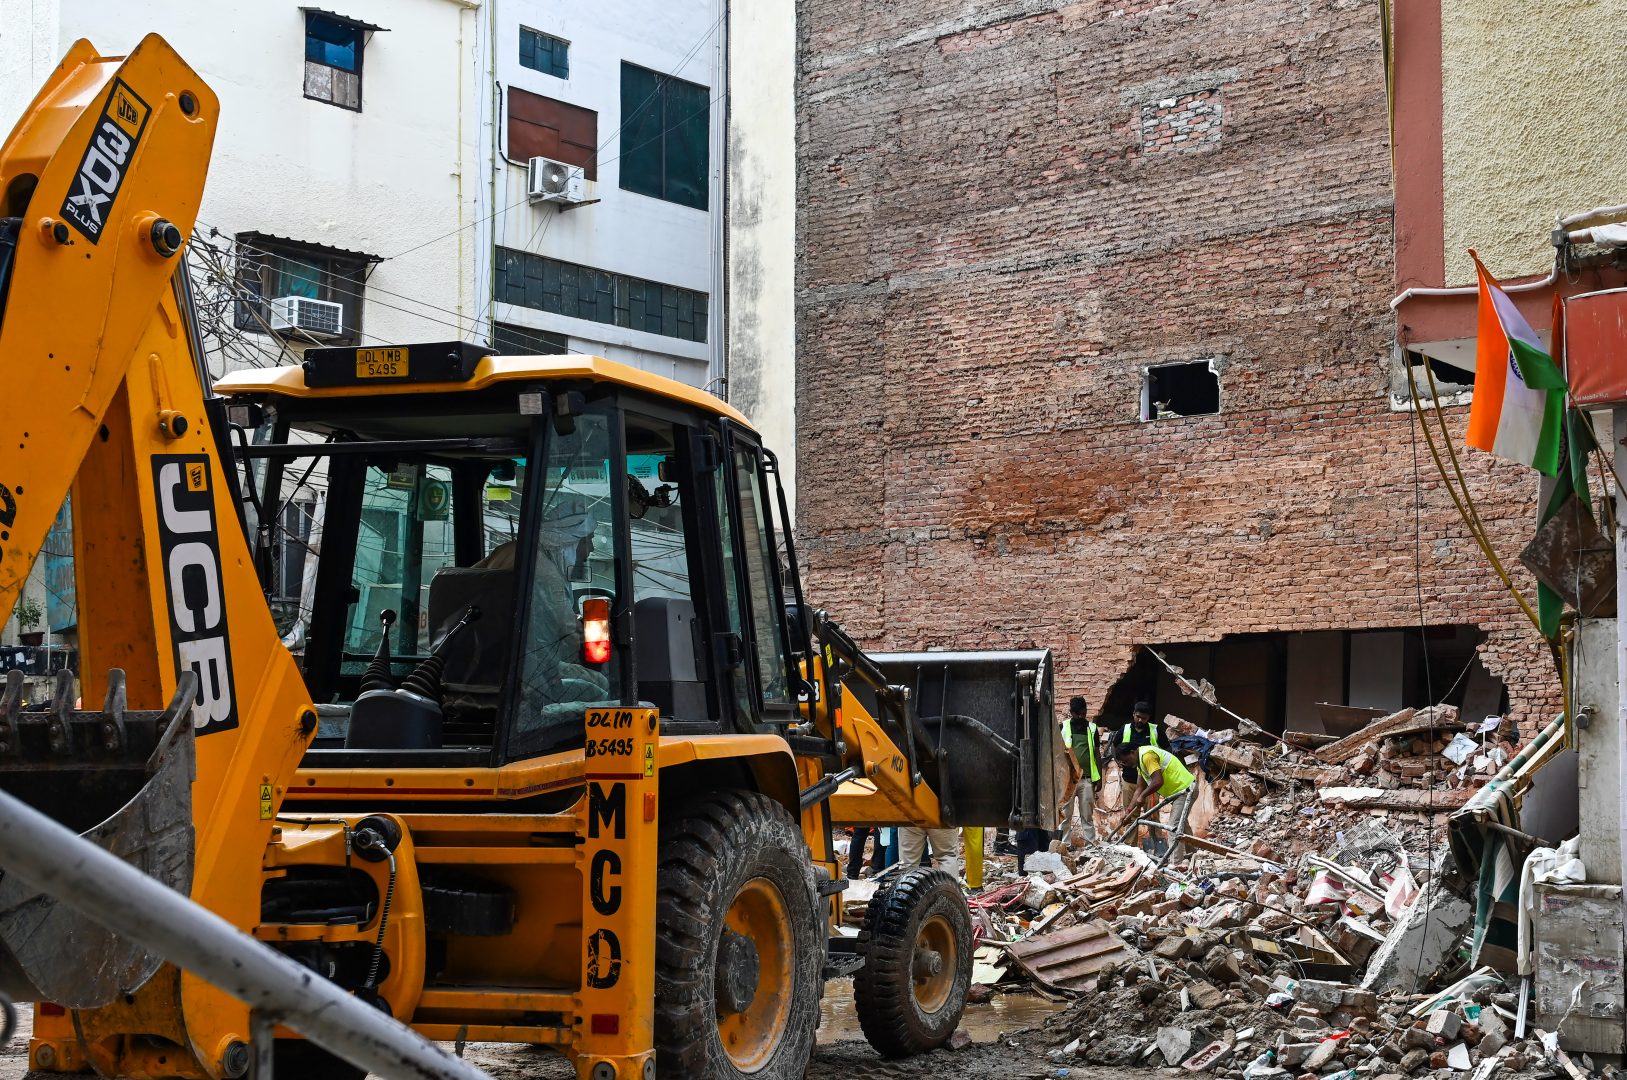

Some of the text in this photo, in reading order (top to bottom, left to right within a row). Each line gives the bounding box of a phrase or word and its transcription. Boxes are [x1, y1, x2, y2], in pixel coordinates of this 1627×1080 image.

[119, 97, 137, 124] JCB
[66, 202, 98, 234] PLUS
[368, 363, 397, 375] 5495
[159, 462, 231, 729] JCB
[587, 782, 626, 989] MCD
